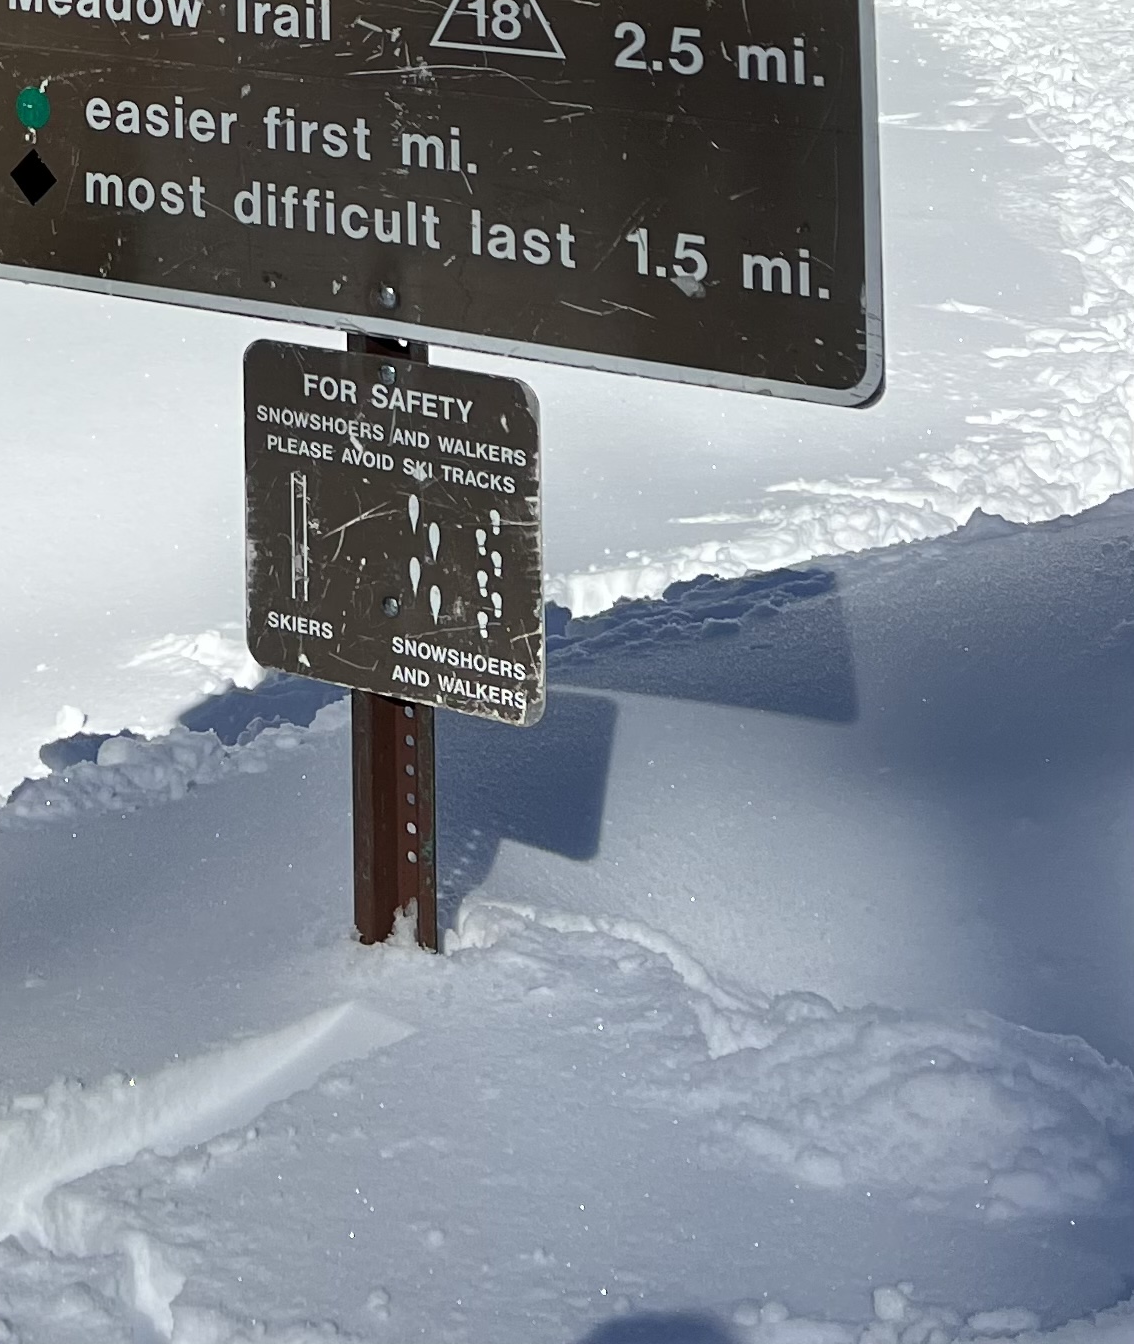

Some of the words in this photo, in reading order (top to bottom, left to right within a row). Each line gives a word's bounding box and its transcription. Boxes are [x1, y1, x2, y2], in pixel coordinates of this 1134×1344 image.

[614, 21, 704, 75] 2.5
[737, 37, 826, 87] mi.
[85, 96, 238, 144] easier
[263, 106, 372, 161] first
[401, 127, 478, 174] mi.
[85, 170, 206, 218] most
[233, 180, 441, 249] difficult
[471, 209, 576, 269] last
[625, 227, 708, 281] 1.5
[742, 248, 830, 299] mi.
[303, 373, 357, 404] FOR
[371, 383, 473, 423] SAFETY
[256, 404, 385, 442] SNOWSHOERS
[392, 427, 430, 450] AND
[437, 435, 527, 467] WALKERS
[267, 435, 333, 461] PLEASE
[341, 448, 394, 471] AVOID
[402, 458, 433, 479] SKI
[441, 464, 516, 495] TRACKS
[267, 611, 334, 639] SKIERS
[391, 636, 527, 681] SNOWSHOERS
[391, 664, 430, 688] AND
[437, 673, 527, 710] WALKERS
